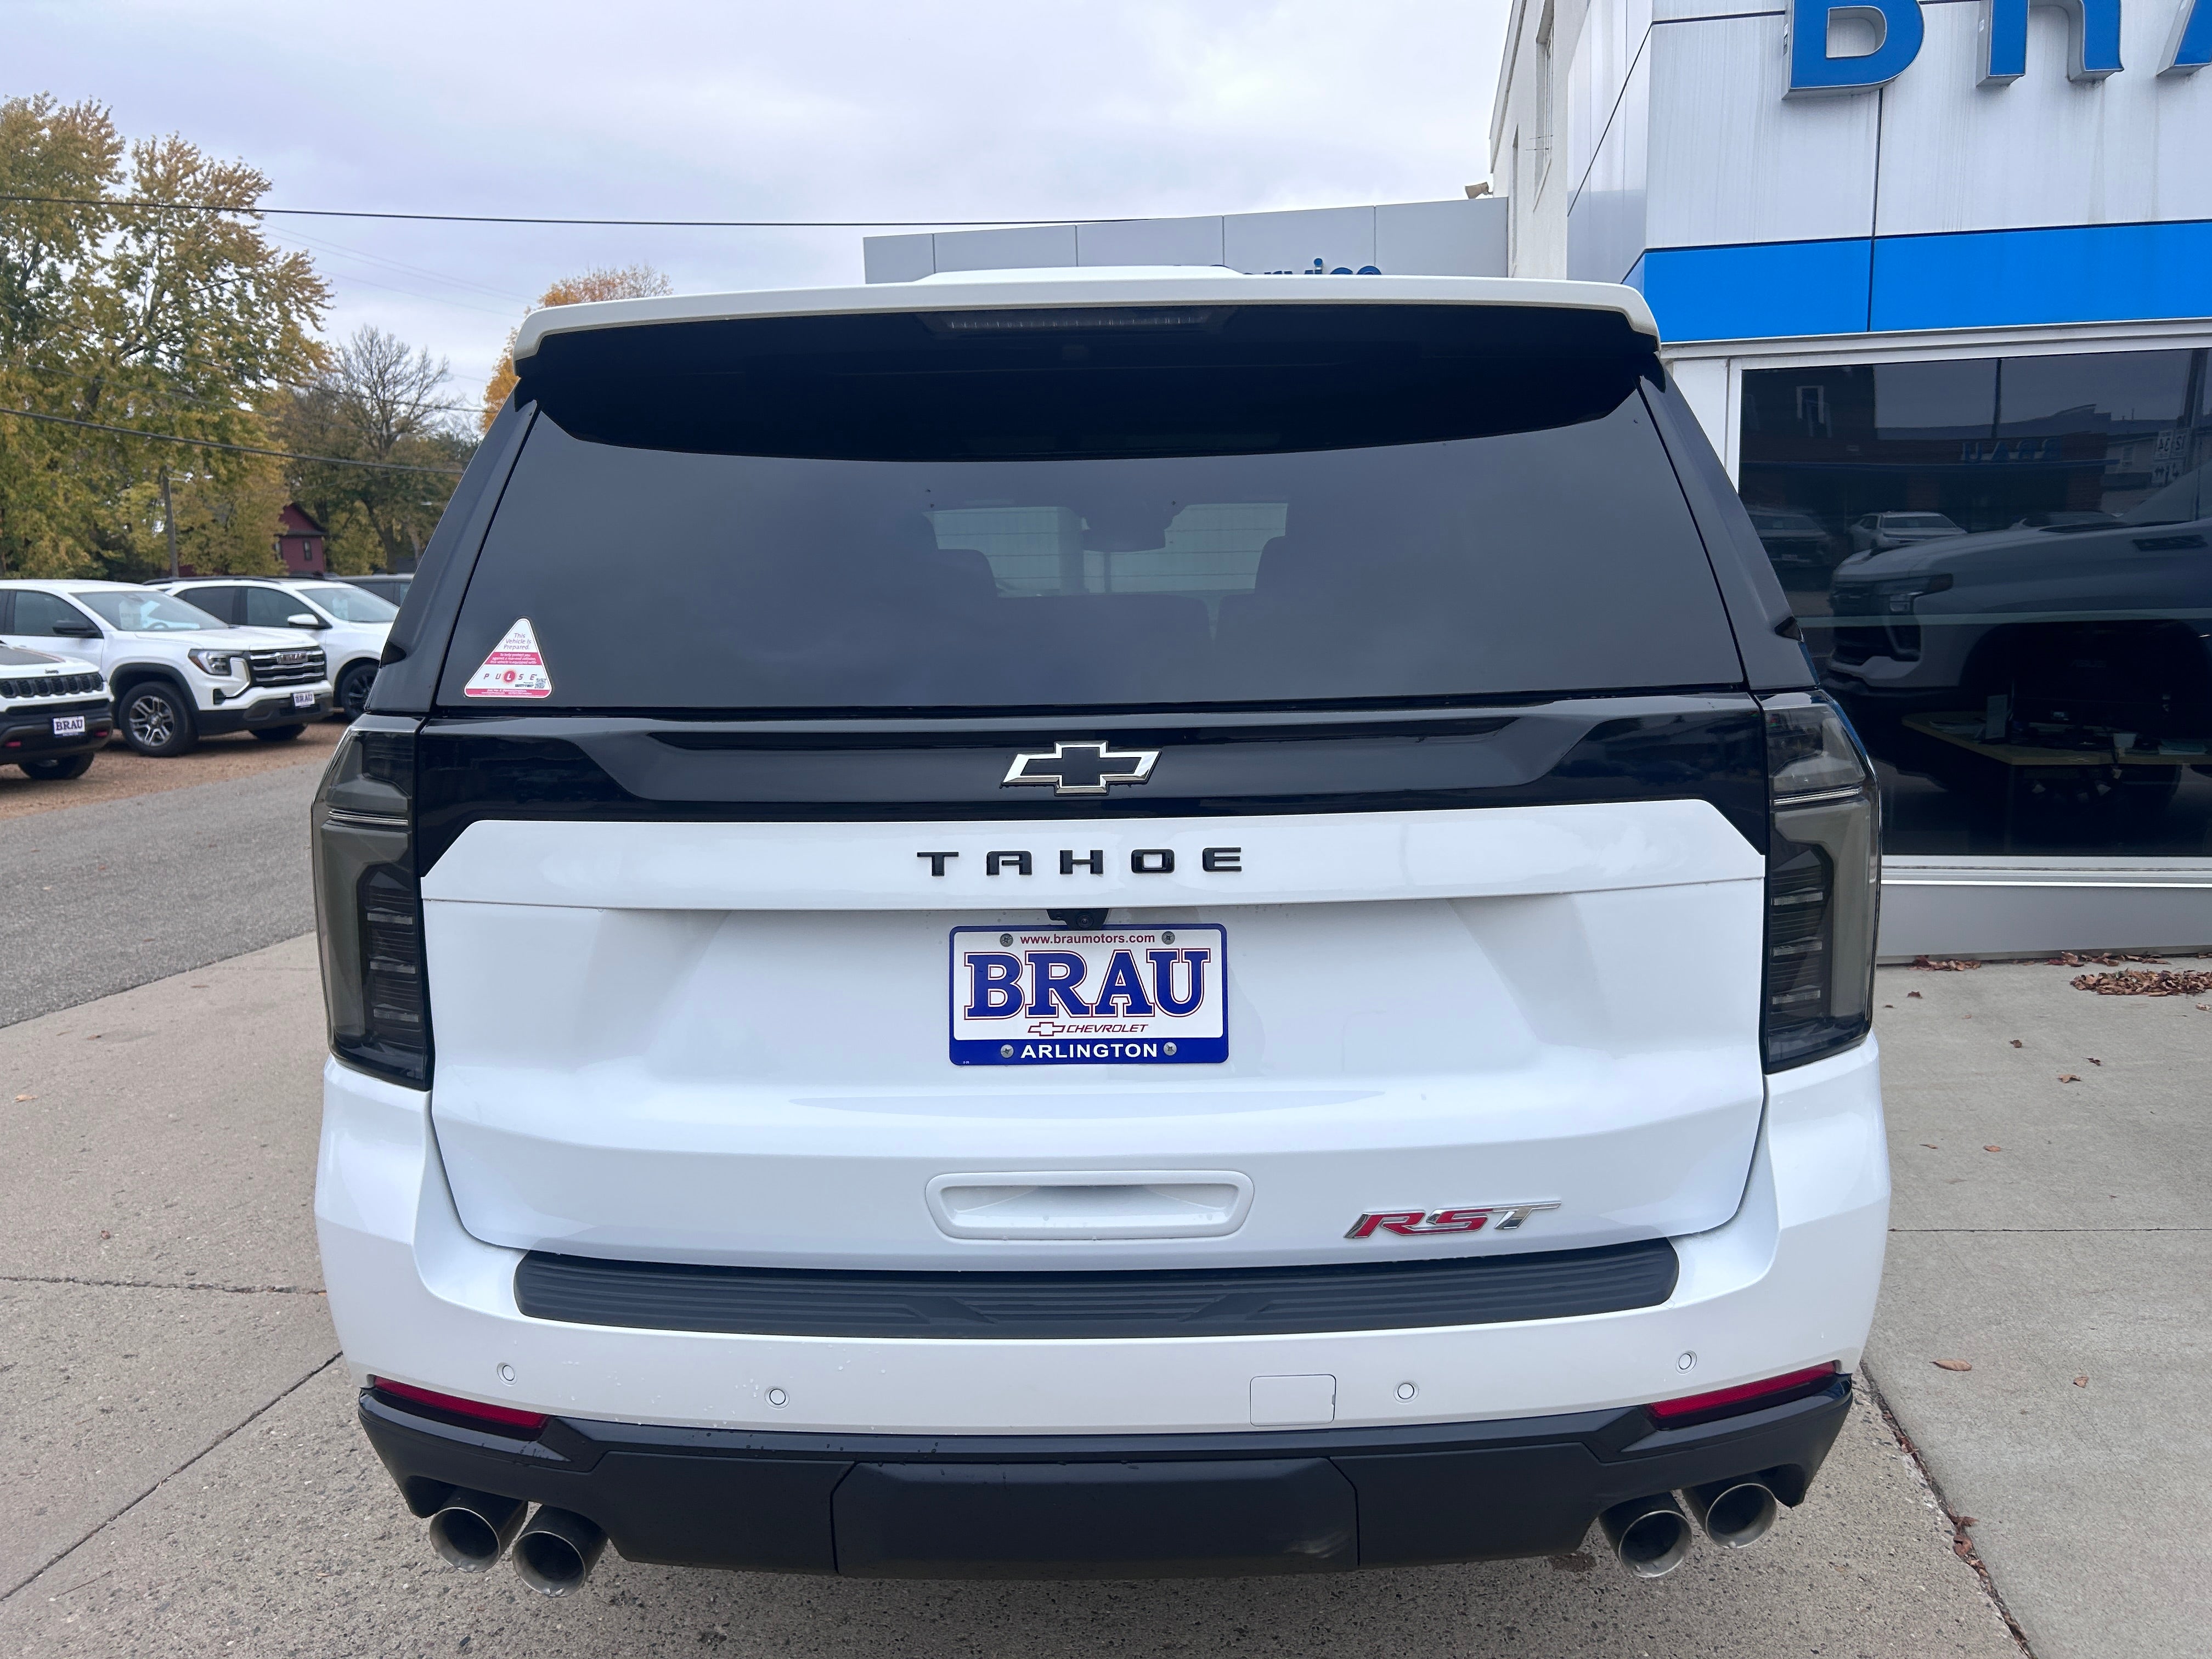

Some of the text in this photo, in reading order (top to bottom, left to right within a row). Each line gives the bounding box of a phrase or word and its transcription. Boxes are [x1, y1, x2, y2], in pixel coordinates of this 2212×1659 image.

[296, 693, 313, 702] BRAU
[55, 719, 83, 731] BRAU
[917, 847, 1242, 877] TAHOE
[1020, 933, 1155, 944] www.braumotors.com
[963, 947, 1211, 1020] BRAU
[1066, 1024, 1148, 1034] CHEVROLET
[1020, 1043, 1158, 1059] ARLINGTON
[1343, 1200, 1562, 1239] RST
